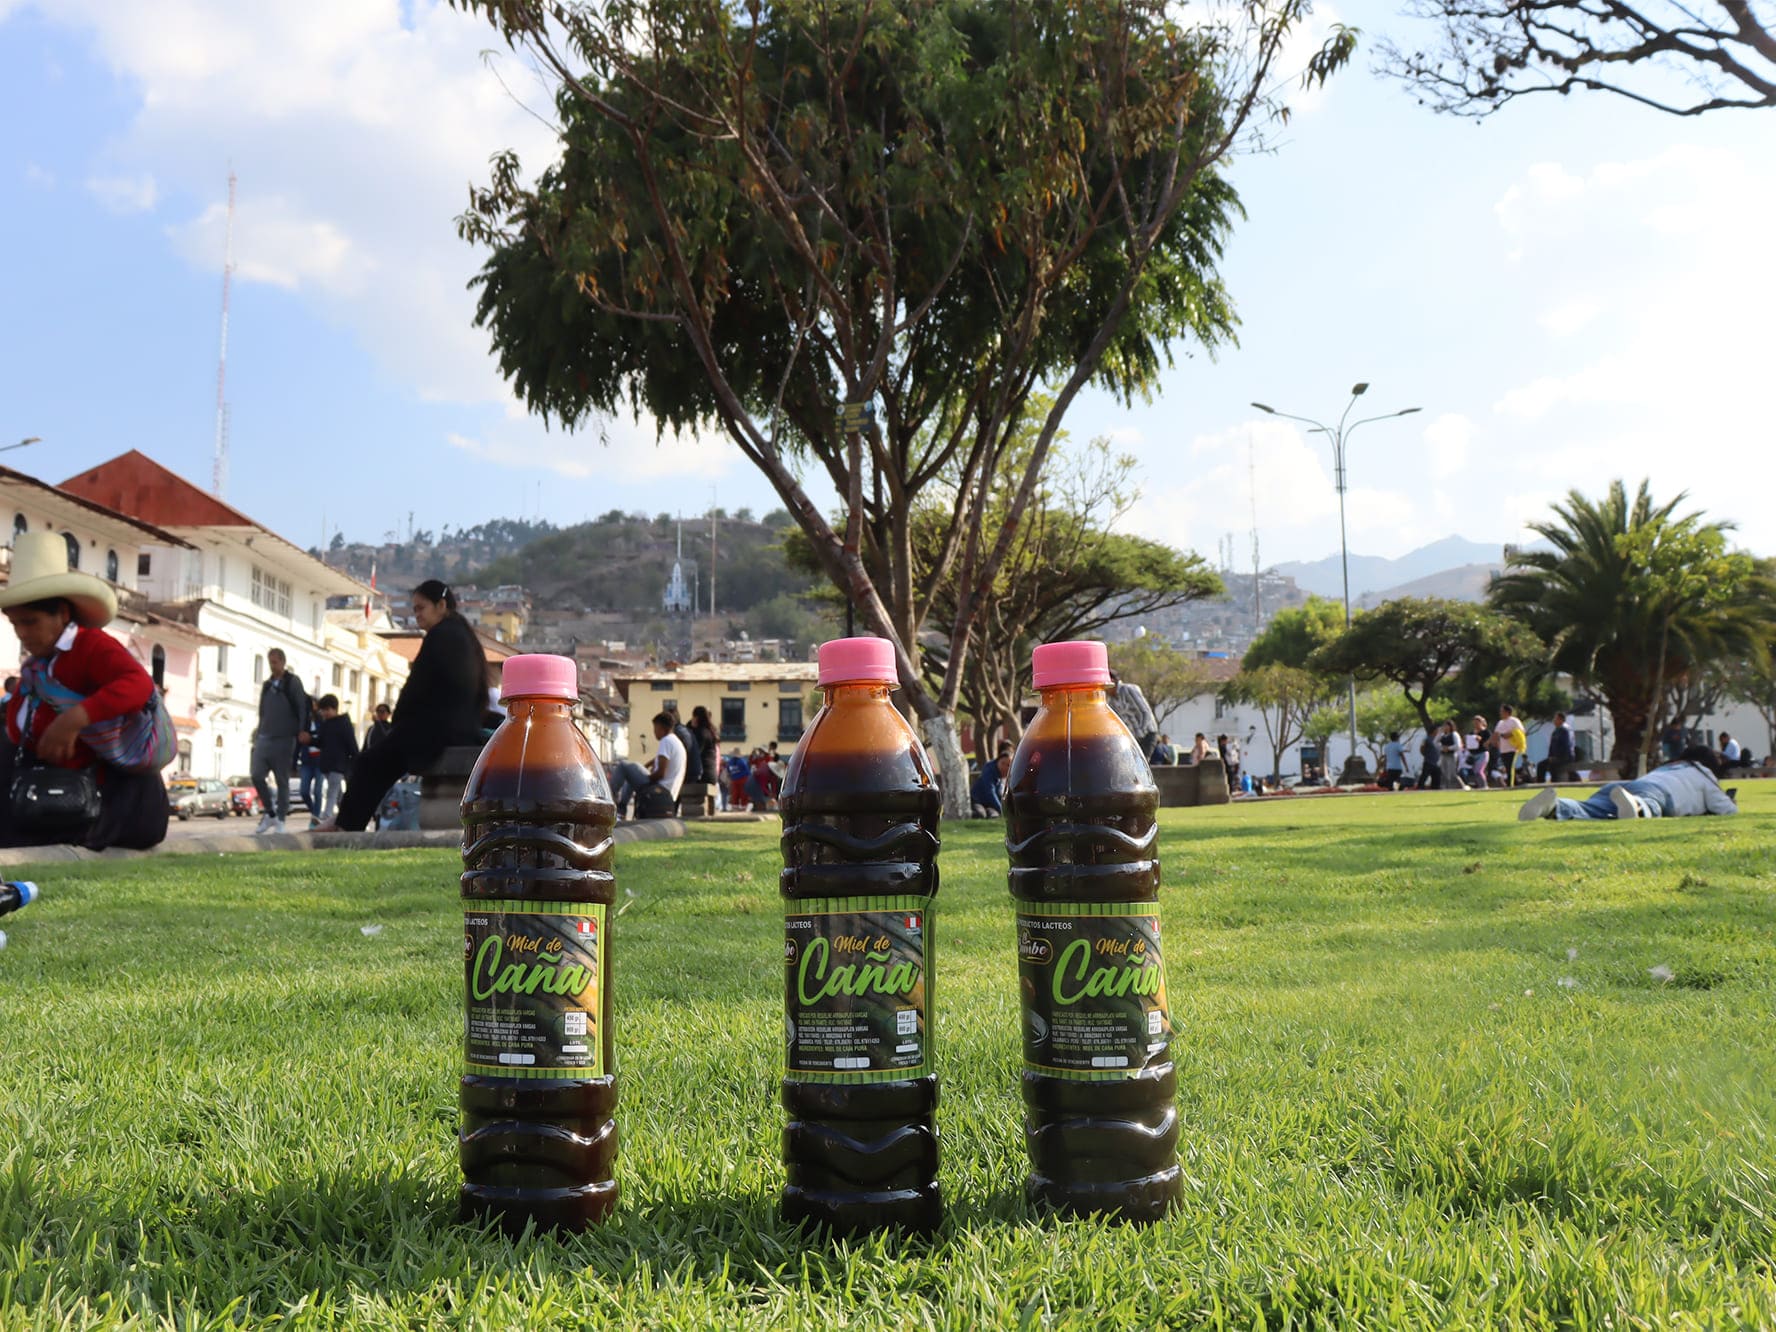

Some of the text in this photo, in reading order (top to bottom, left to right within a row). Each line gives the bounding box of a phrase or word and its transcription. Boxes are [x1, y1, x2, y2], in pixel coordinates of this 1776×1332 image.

[1041, 920, 1073, 930] LACTEOS
[506, 934, 563, 953] Miel de
[833, 935, 890, 953] Miel de
[1095, 937, 1146, 955] Miel de
[472, 934, 592, 1001] Caña
[798, 936, 920, 1006] Caña
[1052, 938, 1161, 1006] Caña
